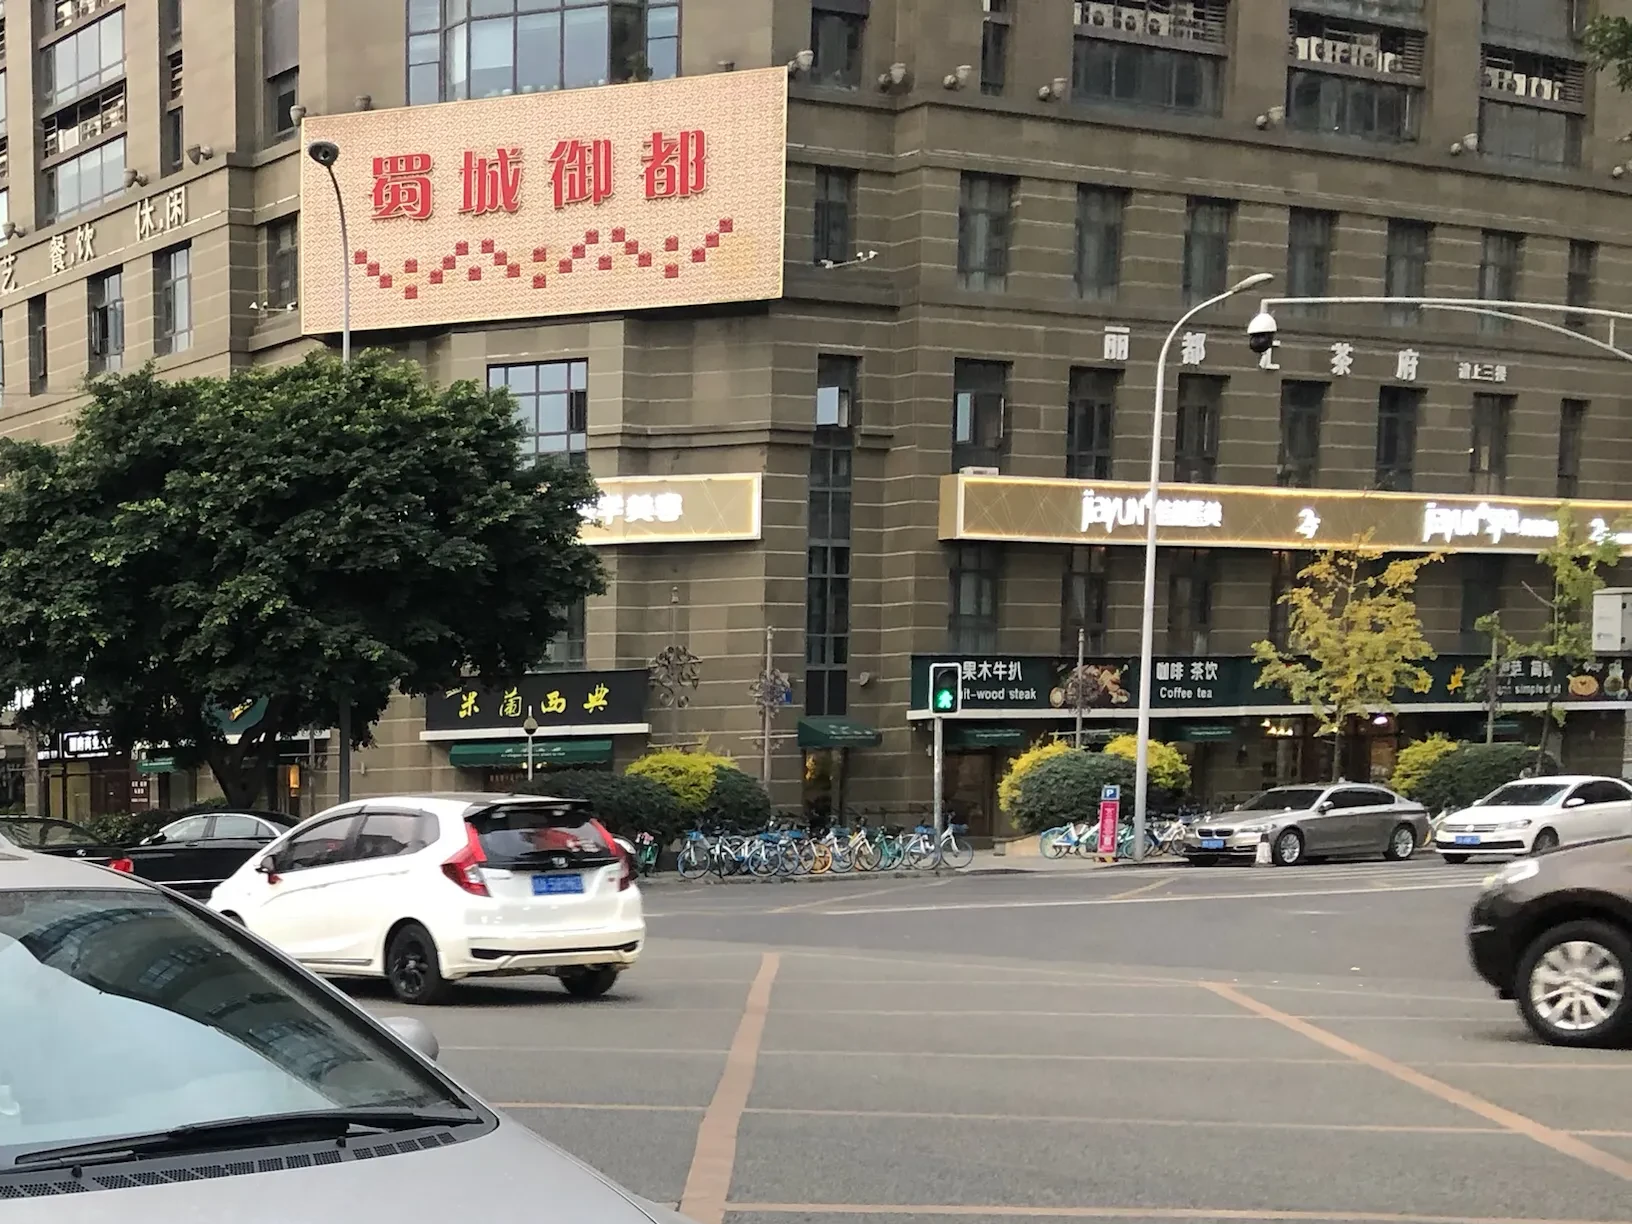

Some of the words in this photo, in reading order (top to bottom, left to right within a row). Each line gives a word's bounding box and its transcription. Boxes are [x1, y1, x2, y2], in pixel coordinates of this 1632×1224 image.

[370, 129, 708, 221] 蜀城御都
[962, 660, 1023, 681] 果木牛扒
[1008, 687, 1037, 700] steak
[1159, 686, 1193, 699] Coffee
[1196, 686, 1213, 699] tea
